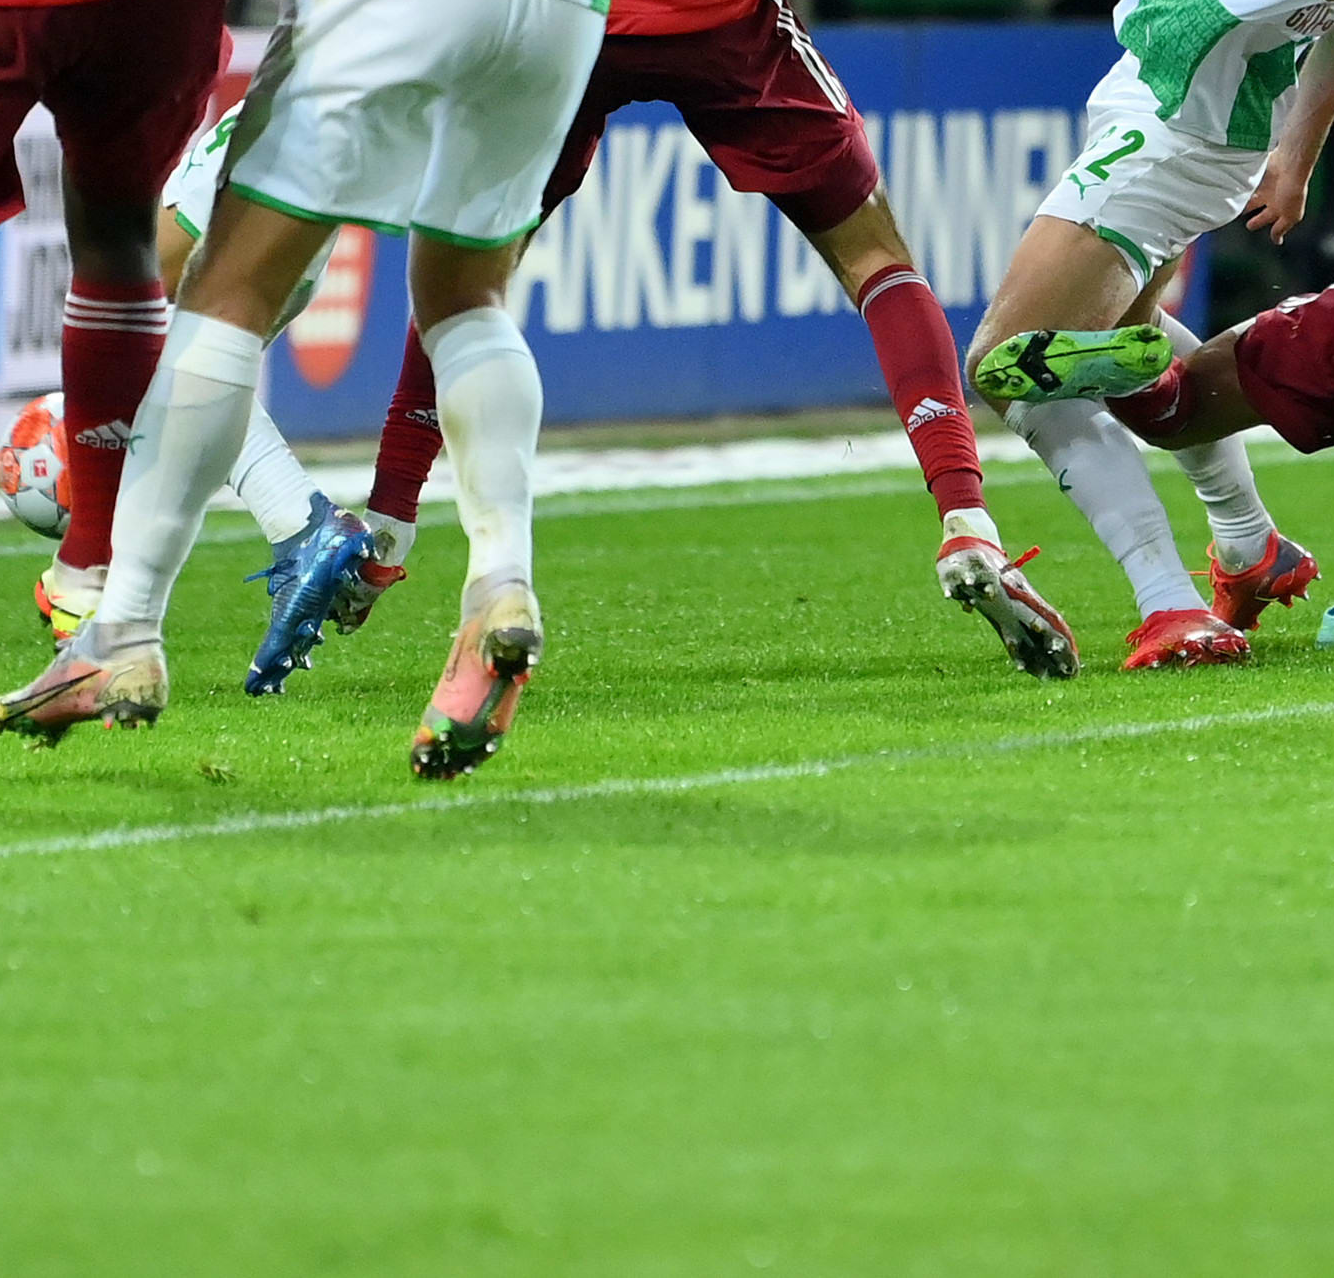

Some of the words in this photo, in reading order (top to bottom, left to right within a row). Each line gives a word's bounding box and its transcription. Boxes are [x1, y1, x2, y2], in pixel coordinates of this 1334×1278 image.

[1085, 126, 1145, 181] 2
[908, 408, 957, 434] adidas
[75, 433, 130, 450] adida
